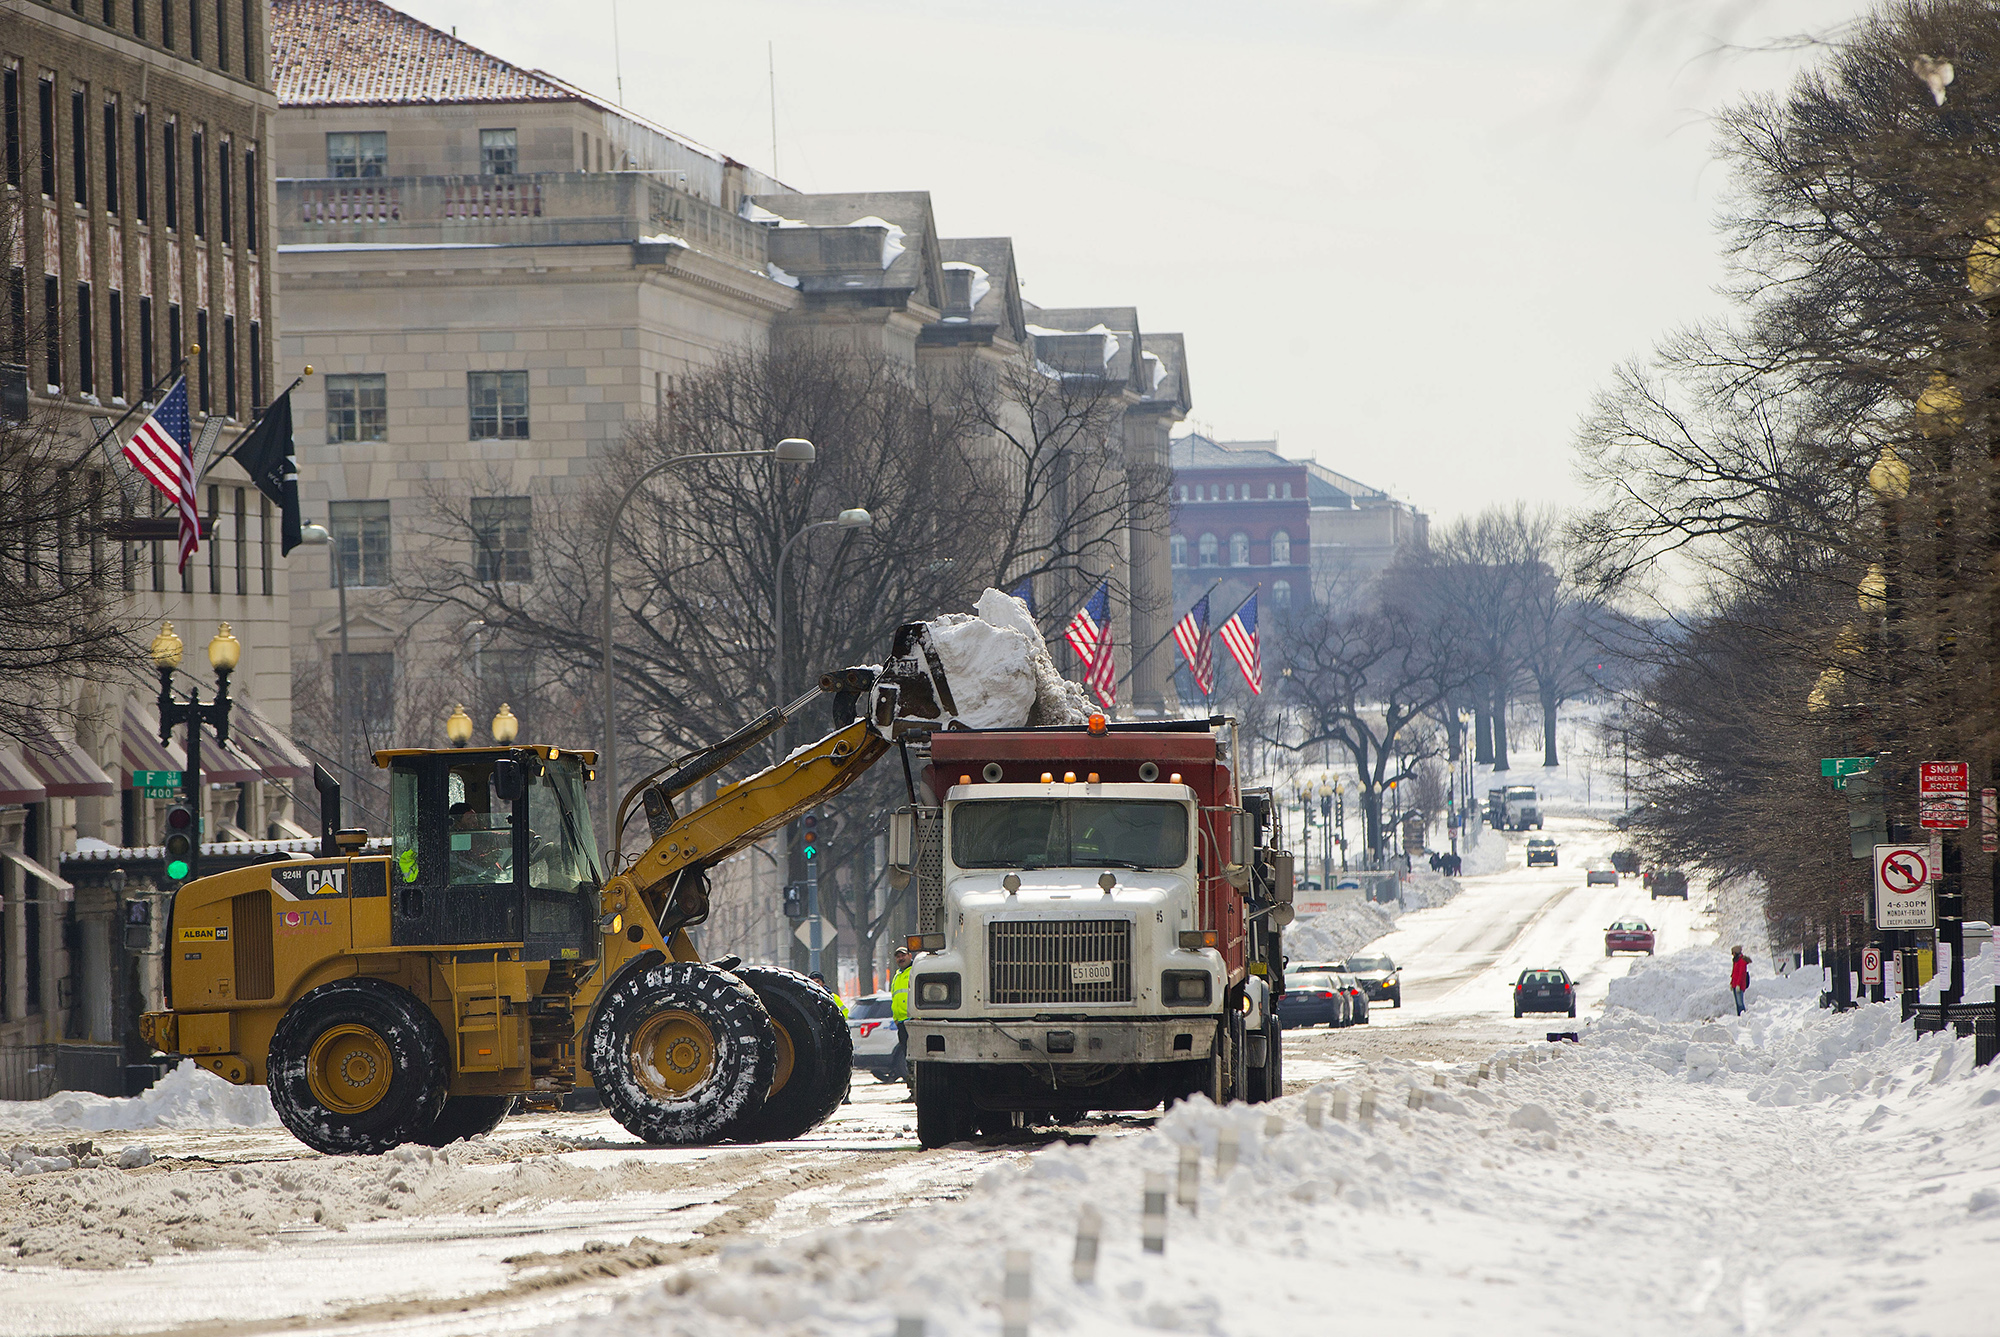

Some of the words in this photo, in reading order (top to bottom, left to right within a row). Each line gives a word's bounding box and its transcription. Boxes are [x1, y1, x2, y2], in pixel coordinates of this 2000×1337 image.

[1836, 760, 1845, 774] F
[1930, 765, 1959, 773] SNOW
[146, 772, 155, 785] F
[147, 789, 171, 798] 1400
[282, 870, 302, 880] 924H
[306, 868, 345, 895] CAT
[276, 911, 332, 928] TOTAL
[184, 930, 213, 938] ALBAN
